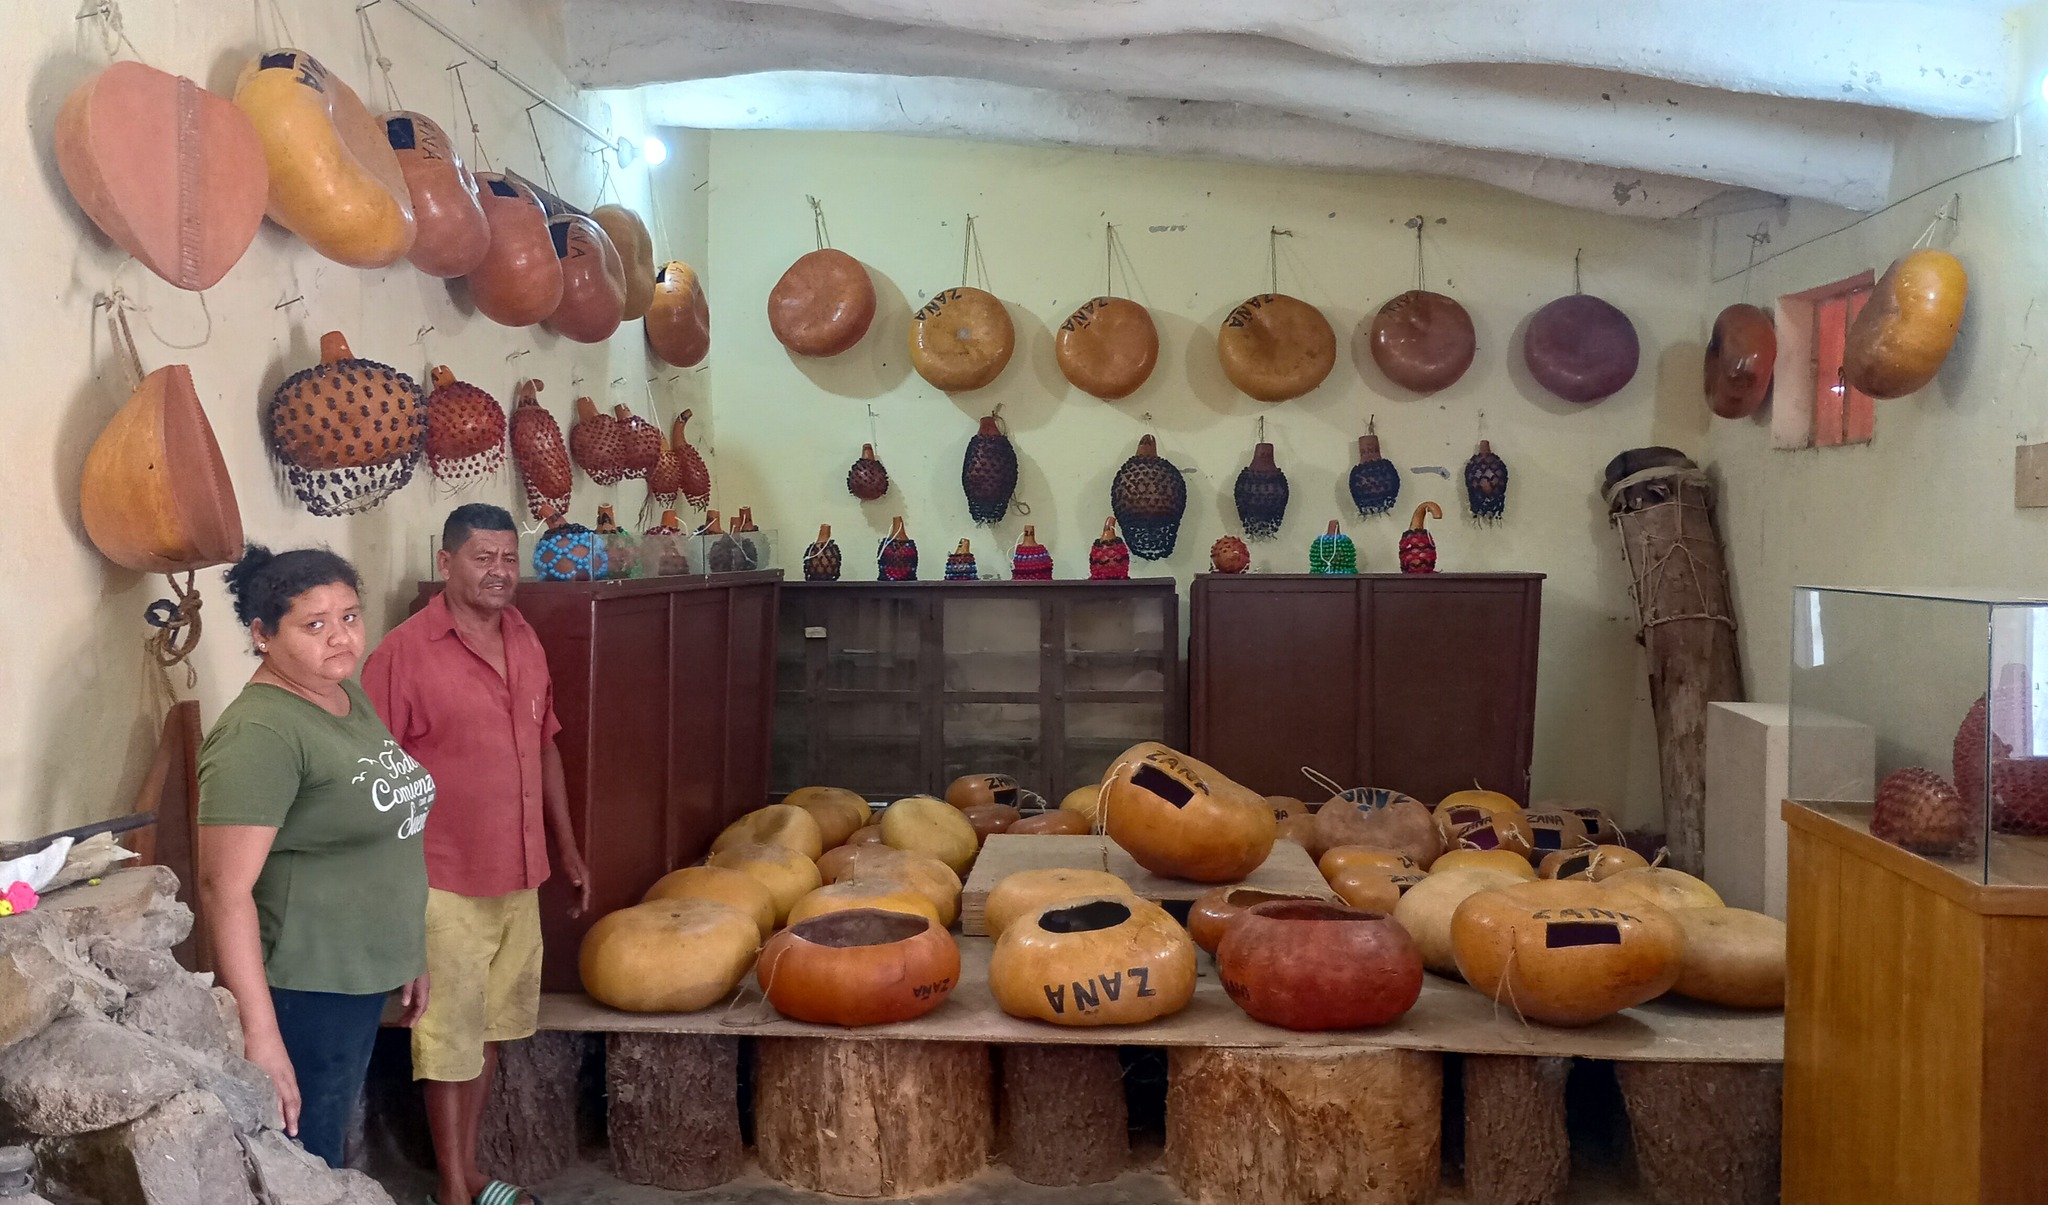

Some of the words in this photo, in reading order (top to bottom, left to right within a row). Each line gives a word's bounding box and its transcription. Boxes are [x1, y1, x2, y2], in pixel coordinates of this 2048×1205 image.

[914, 288, 962, 321] ZAÑA
[1061, 298, 1108, 332] ZAÑA
[372, 773, 436, 812] Comienz
